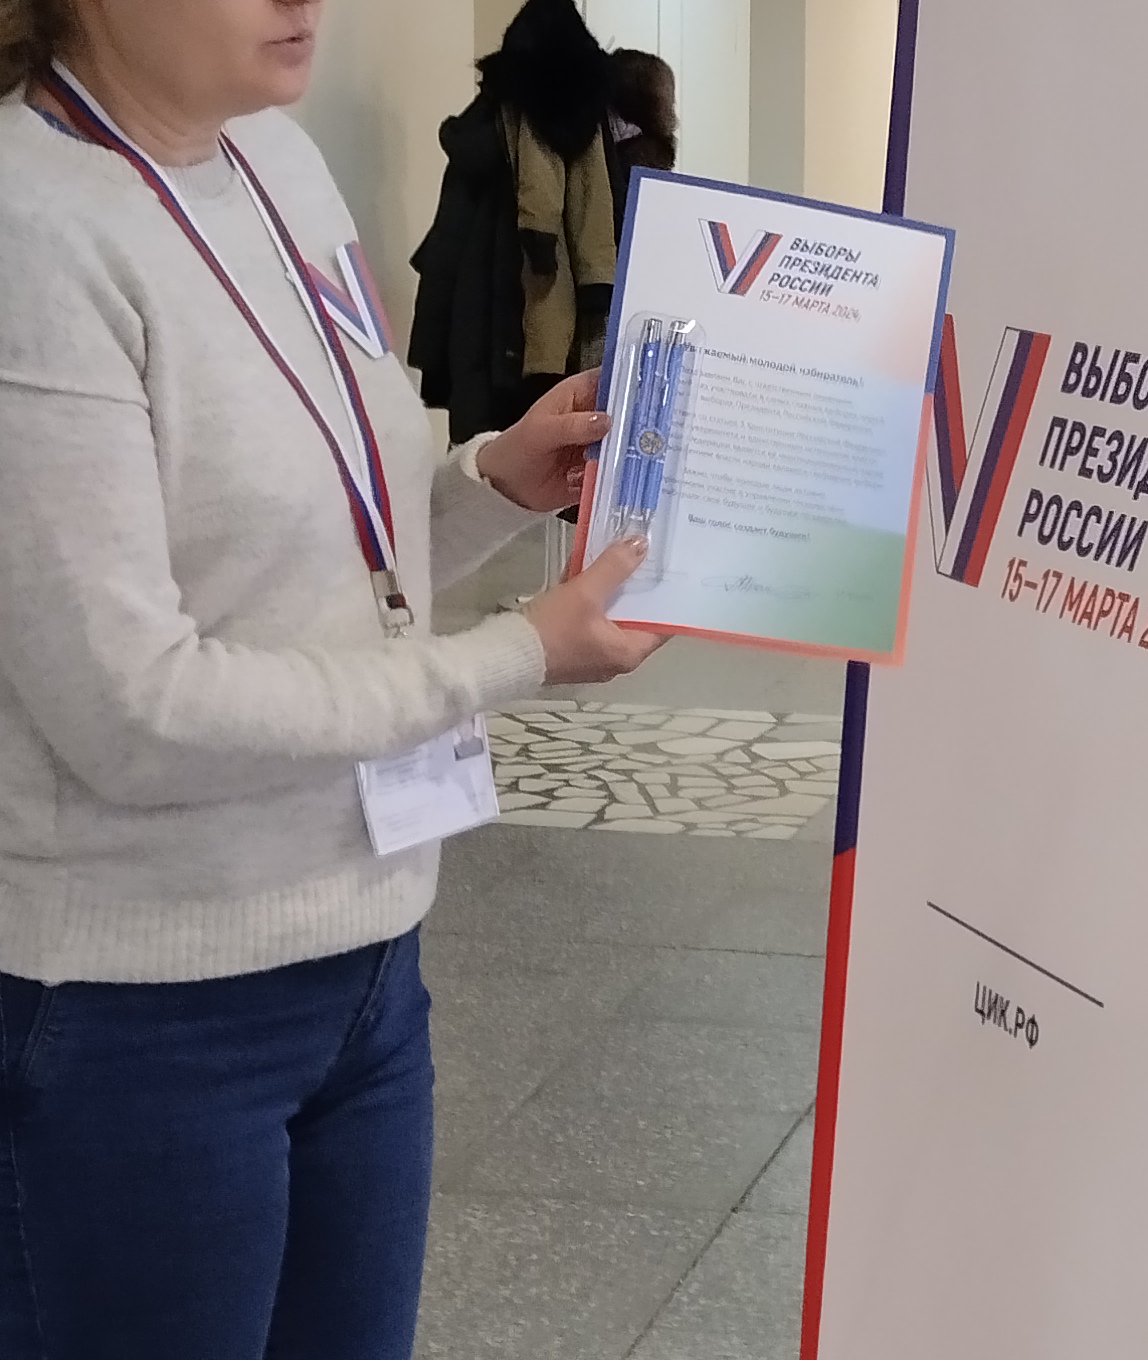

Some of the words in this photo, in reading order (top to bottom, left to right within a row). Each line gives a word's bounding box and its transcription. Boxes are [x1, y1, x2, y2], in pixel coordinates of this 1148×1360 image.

[790, 237, 862, 264] ВЫБОРЫ
[768, 272, 835, 297] РОССИИ
[778, 255, 879, 289] ПРЕЗИДЕНТА
[792, 295, 831, 315] МАРТА
[832, 304, 861, 323] 2024
[683, 342, 746, 363] Увжаемый
[1018, 488, 1148, 572] РОССИИ
[1058, 575, 1141, 643] МАРТА
[974, 981, 1039, 1049] ЦИК.РФ
